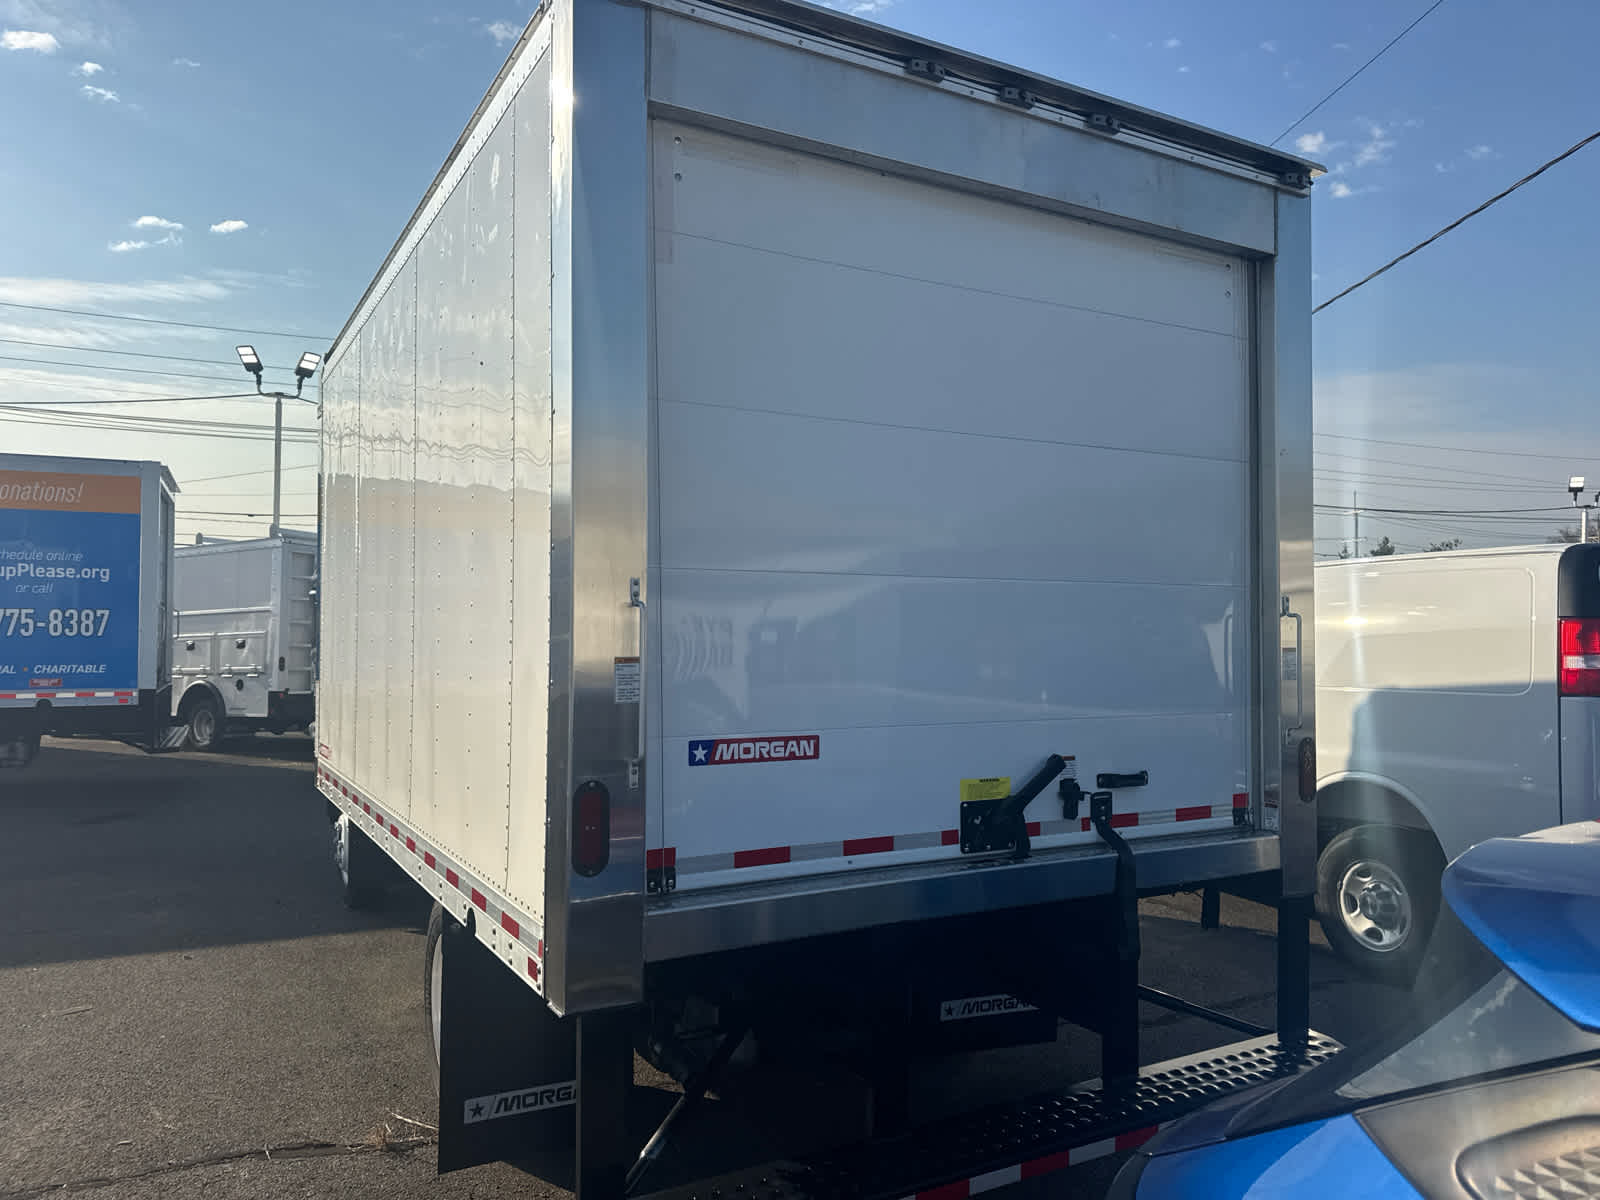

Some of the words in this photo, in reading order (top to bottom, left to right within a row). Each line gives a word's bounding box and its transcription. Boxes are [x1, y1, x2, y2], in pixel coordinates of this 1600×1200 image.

[0, 481, 84, 503] onations!
[0, 548, 43, 561] hedule
[46, 551, 83, 562] online
[16, 584, 31, 593] or
[32, 583, 54, 594] call
[0, 664, 17, 674] AL
[33, 664, 107, 675] CHARITABLE
[714, 739, 817, 761] MORGAN
[495, 1085, 577, 1114] MORG
